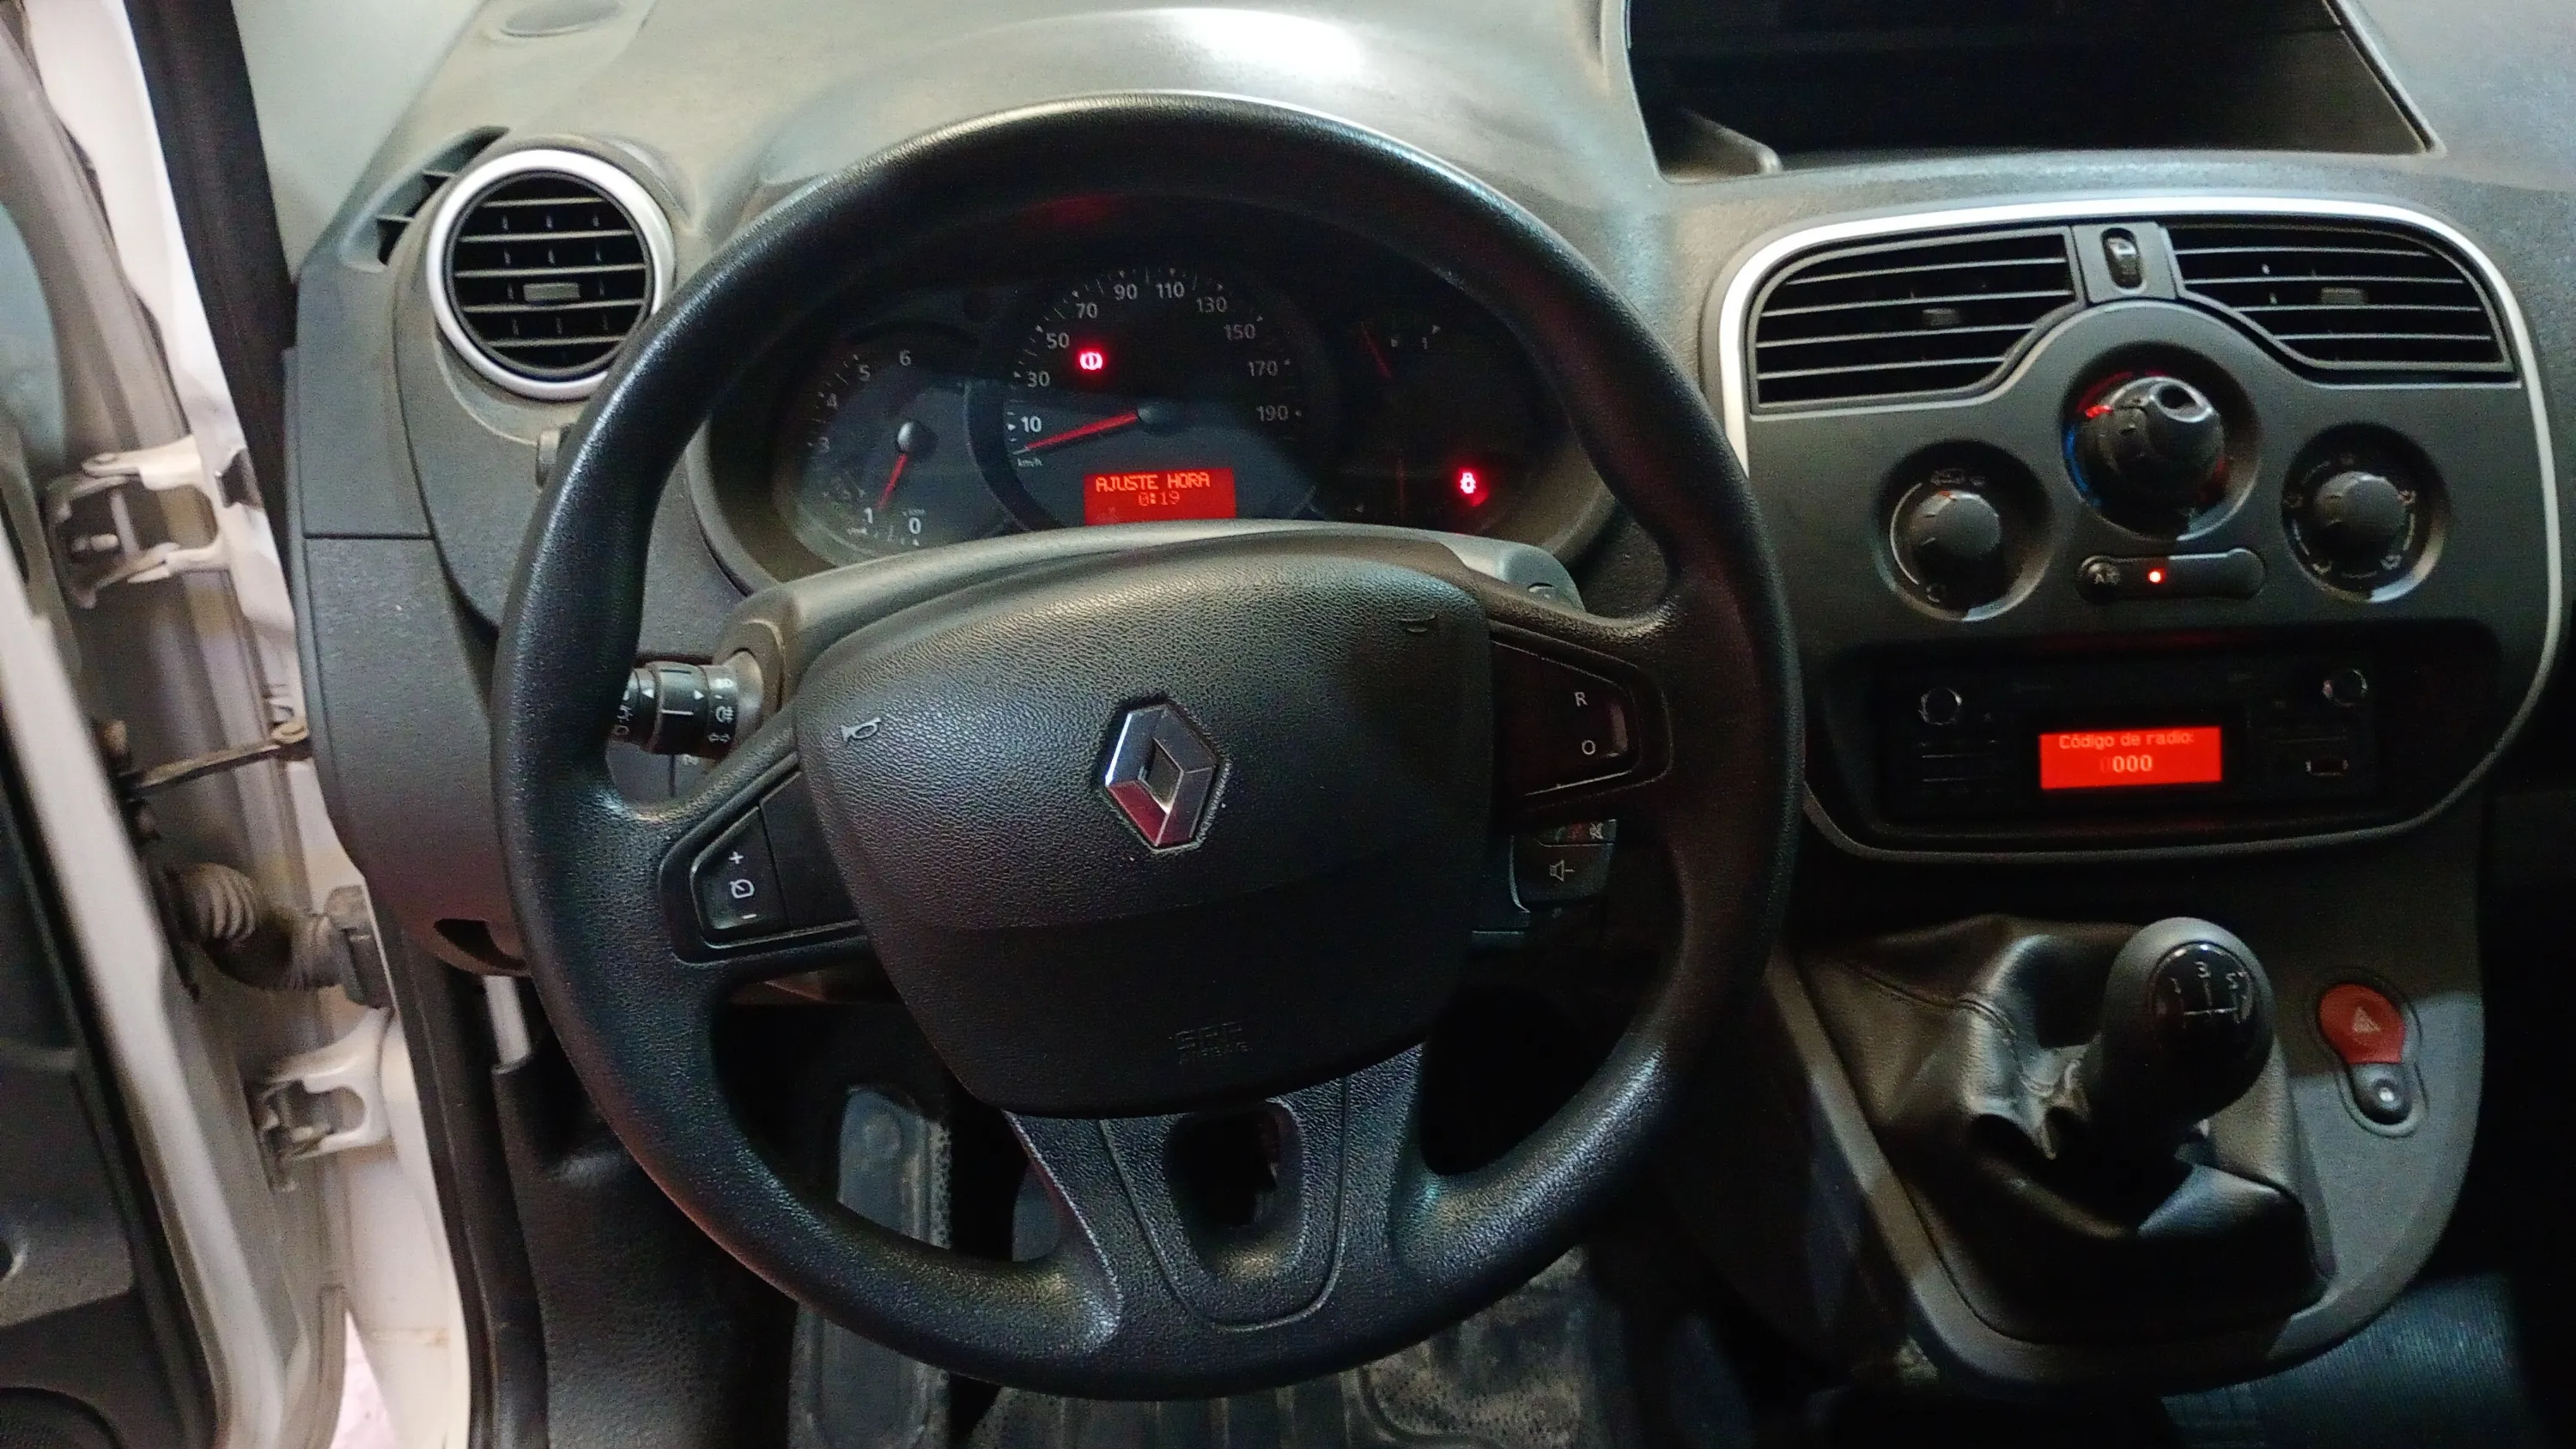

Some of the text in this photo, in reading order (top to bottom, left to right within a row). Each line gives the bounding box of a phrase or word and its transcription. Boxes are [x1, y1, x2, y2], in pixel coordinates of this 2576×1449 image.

[1114, 283, 1138, 300] 90
[1156, 282, 1185, 299] 110
[1076, 303, 1098, 319] 70
[1197, 296, 1228, 313] 130
[1046, 332, 1070, 349] 50
[1224, 323, 1257, 341] 150
[899, 349, 912, 367] 6
[859, 364, 871, 382] 5
[1248, 361, 1279, 377] 170
[1027, 370, 1051, 387] 30
[1255, 405, 1289, 421] 190
[1020, 415, 1042, 433] 10
[1096, 471, 1211, 493] AJUSTE HORA
[864, 507, 873, 524] 1
[908, 517, 921, 535] 0
[1574, 692, 1588, 706] R
[2059, 734, 2115, 750] Código
[2120, 732, 2141, 747] de
